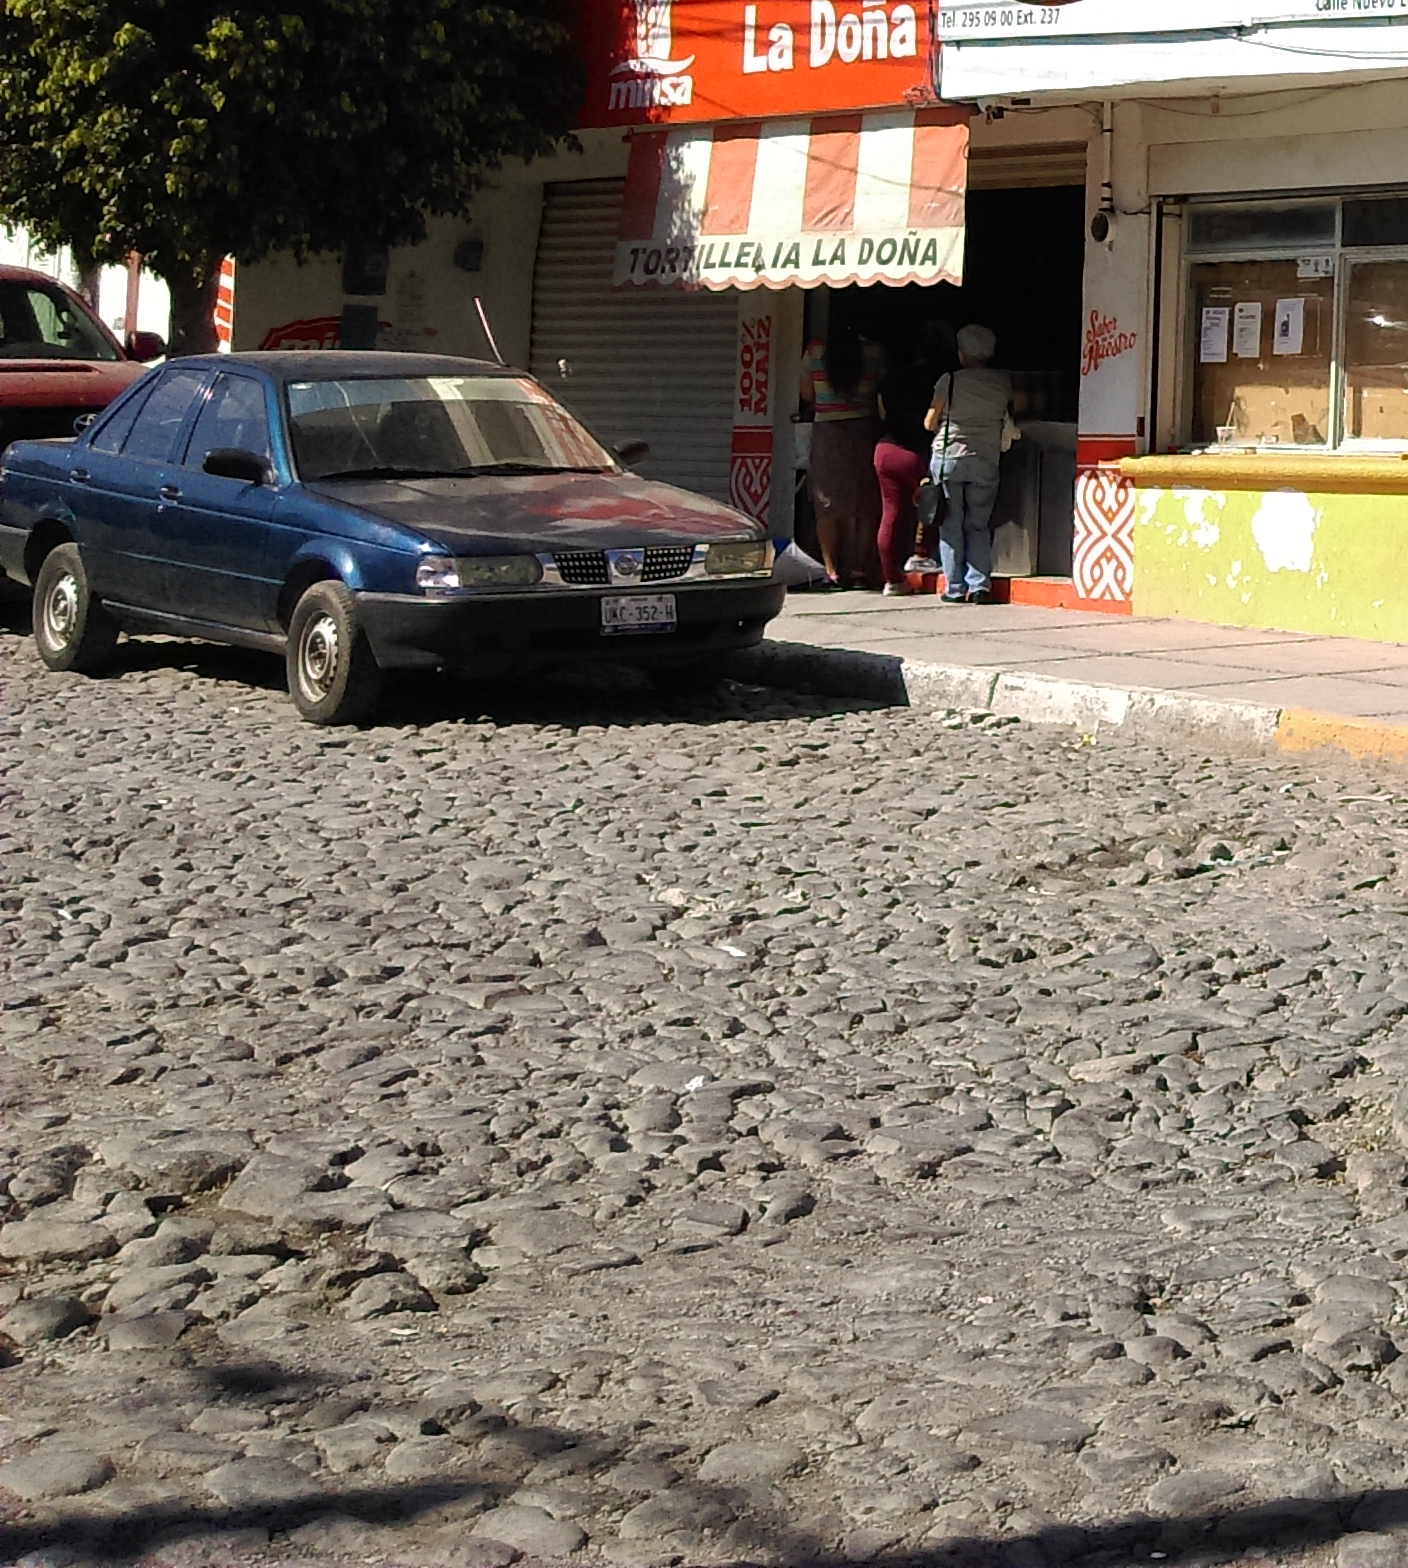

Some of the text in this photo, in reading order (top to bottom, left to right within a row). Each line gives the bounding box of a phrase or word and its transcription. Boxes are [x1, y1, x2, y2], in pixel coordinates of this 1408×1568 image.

[742, 5, 794, 74] La
[941, 8, 1060, 28] Tel. 295 09 00 Ext. 237
[811, 237, 846, 266] LA
[857, 231, 938, 267] DOÑA
[739, 317, 756, 413] 100%
[754, 315, 772, 417] MAIZ
